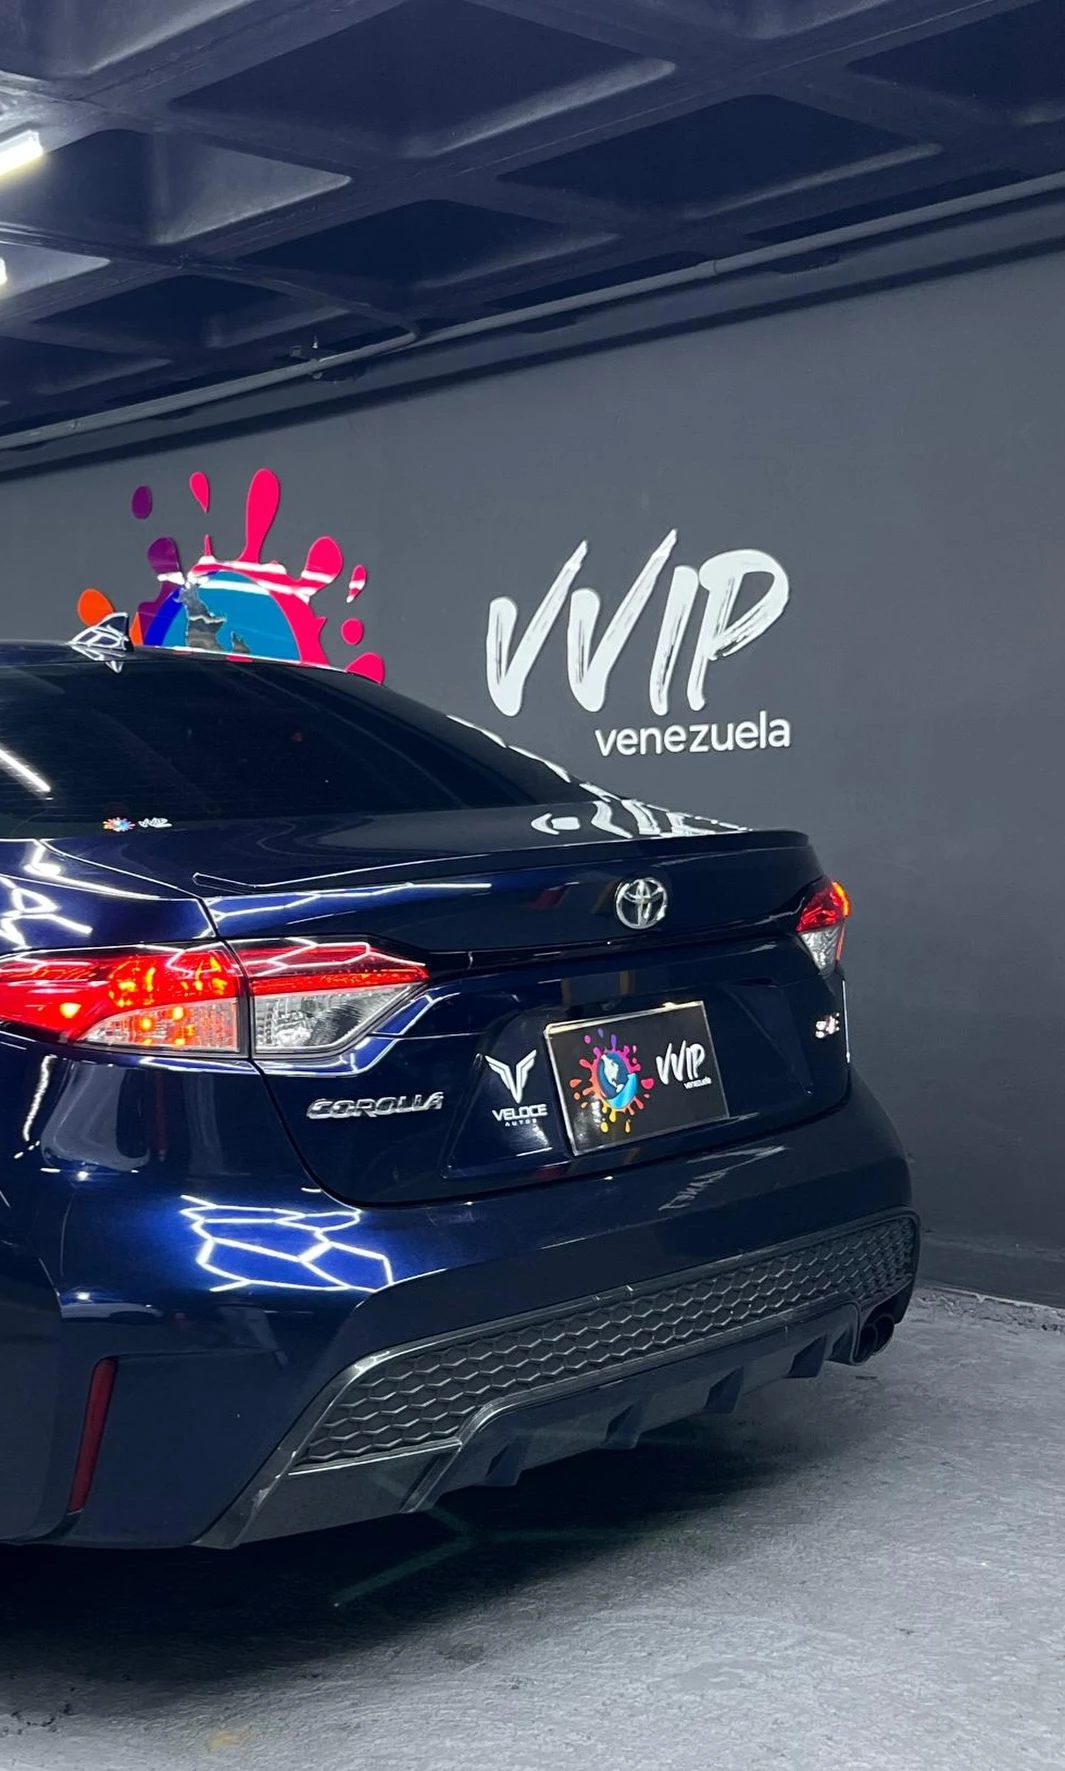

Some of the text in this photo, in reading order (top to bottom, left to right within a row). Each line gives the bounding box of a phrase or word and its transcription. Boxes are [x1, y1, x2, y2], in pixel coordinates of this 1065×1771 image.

[486, 528, 790, 717] VVIP
[595, 711, 792, 757] venezuela
[655, 1040, 705, 1085] VVIP
[306, 1091, 444, 1120] COROLLA
[491, 1103, 548, 1122] VELOCE
